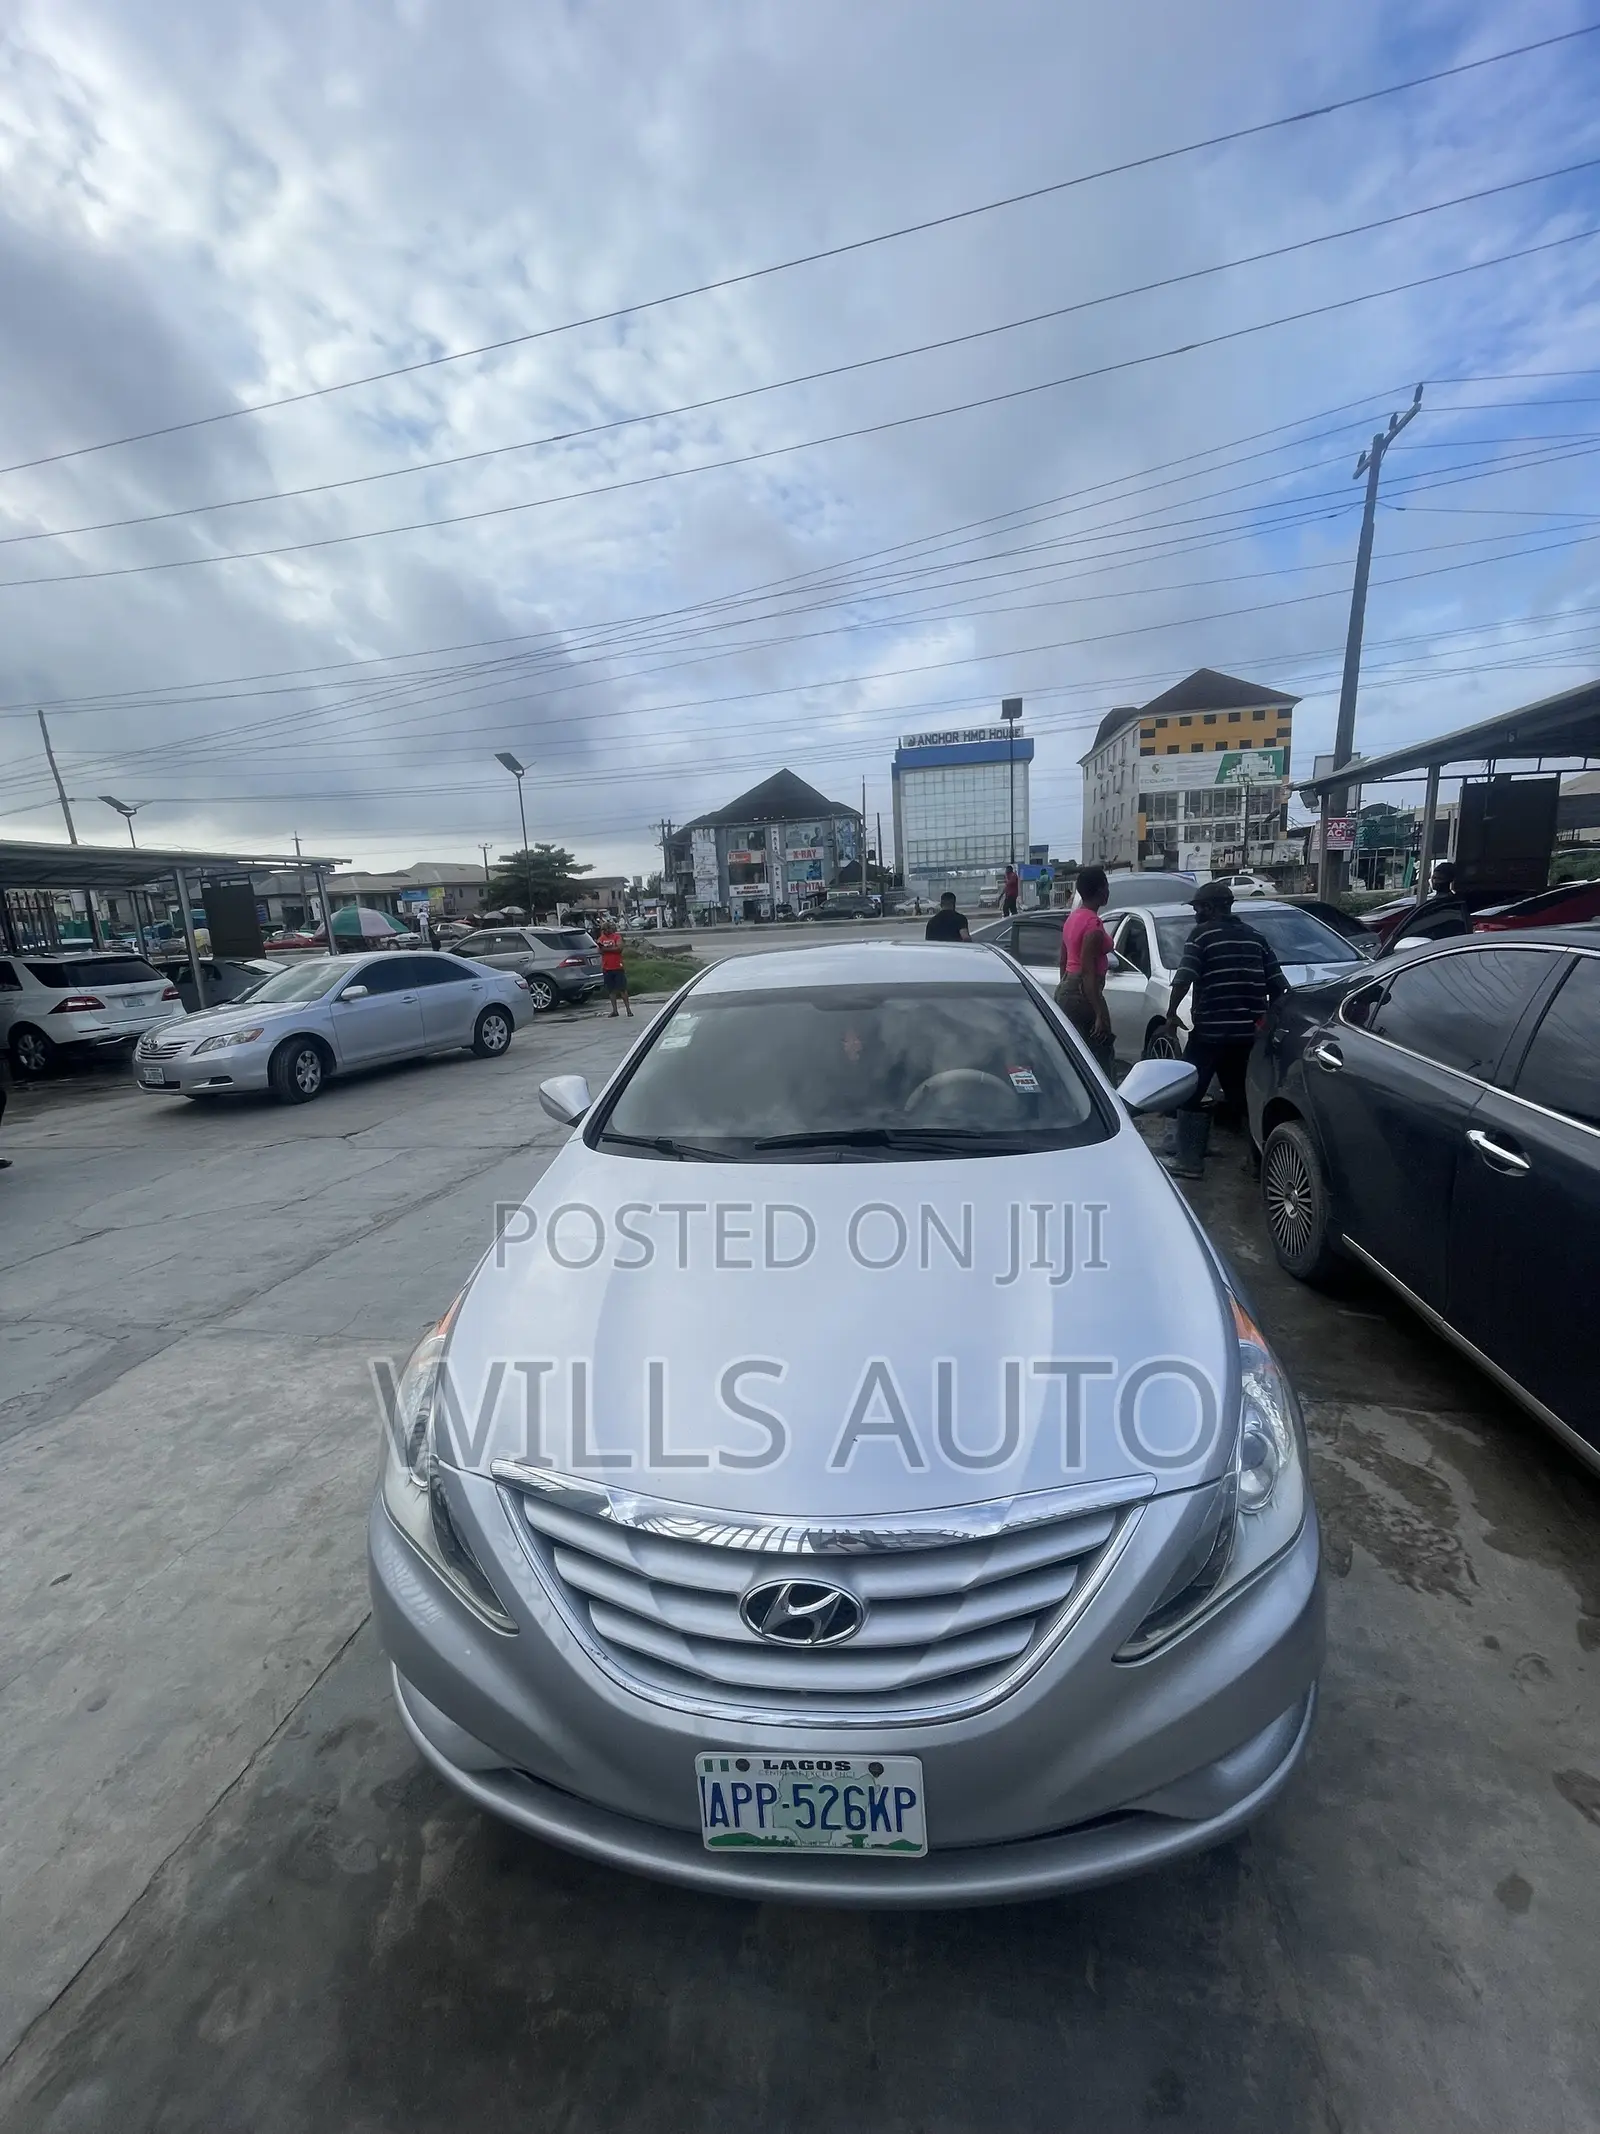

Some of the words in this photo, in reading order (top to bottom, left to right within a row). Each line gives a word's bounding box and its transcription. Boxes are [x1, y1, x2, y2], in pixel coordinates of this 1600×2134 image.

[917, 731, 959, 746] ANCHOR
[963, 728, 986, 742] HMO
[793, 849, 817, 859] X-RAY
[762, 1759, 851, 1771] LAGOS
